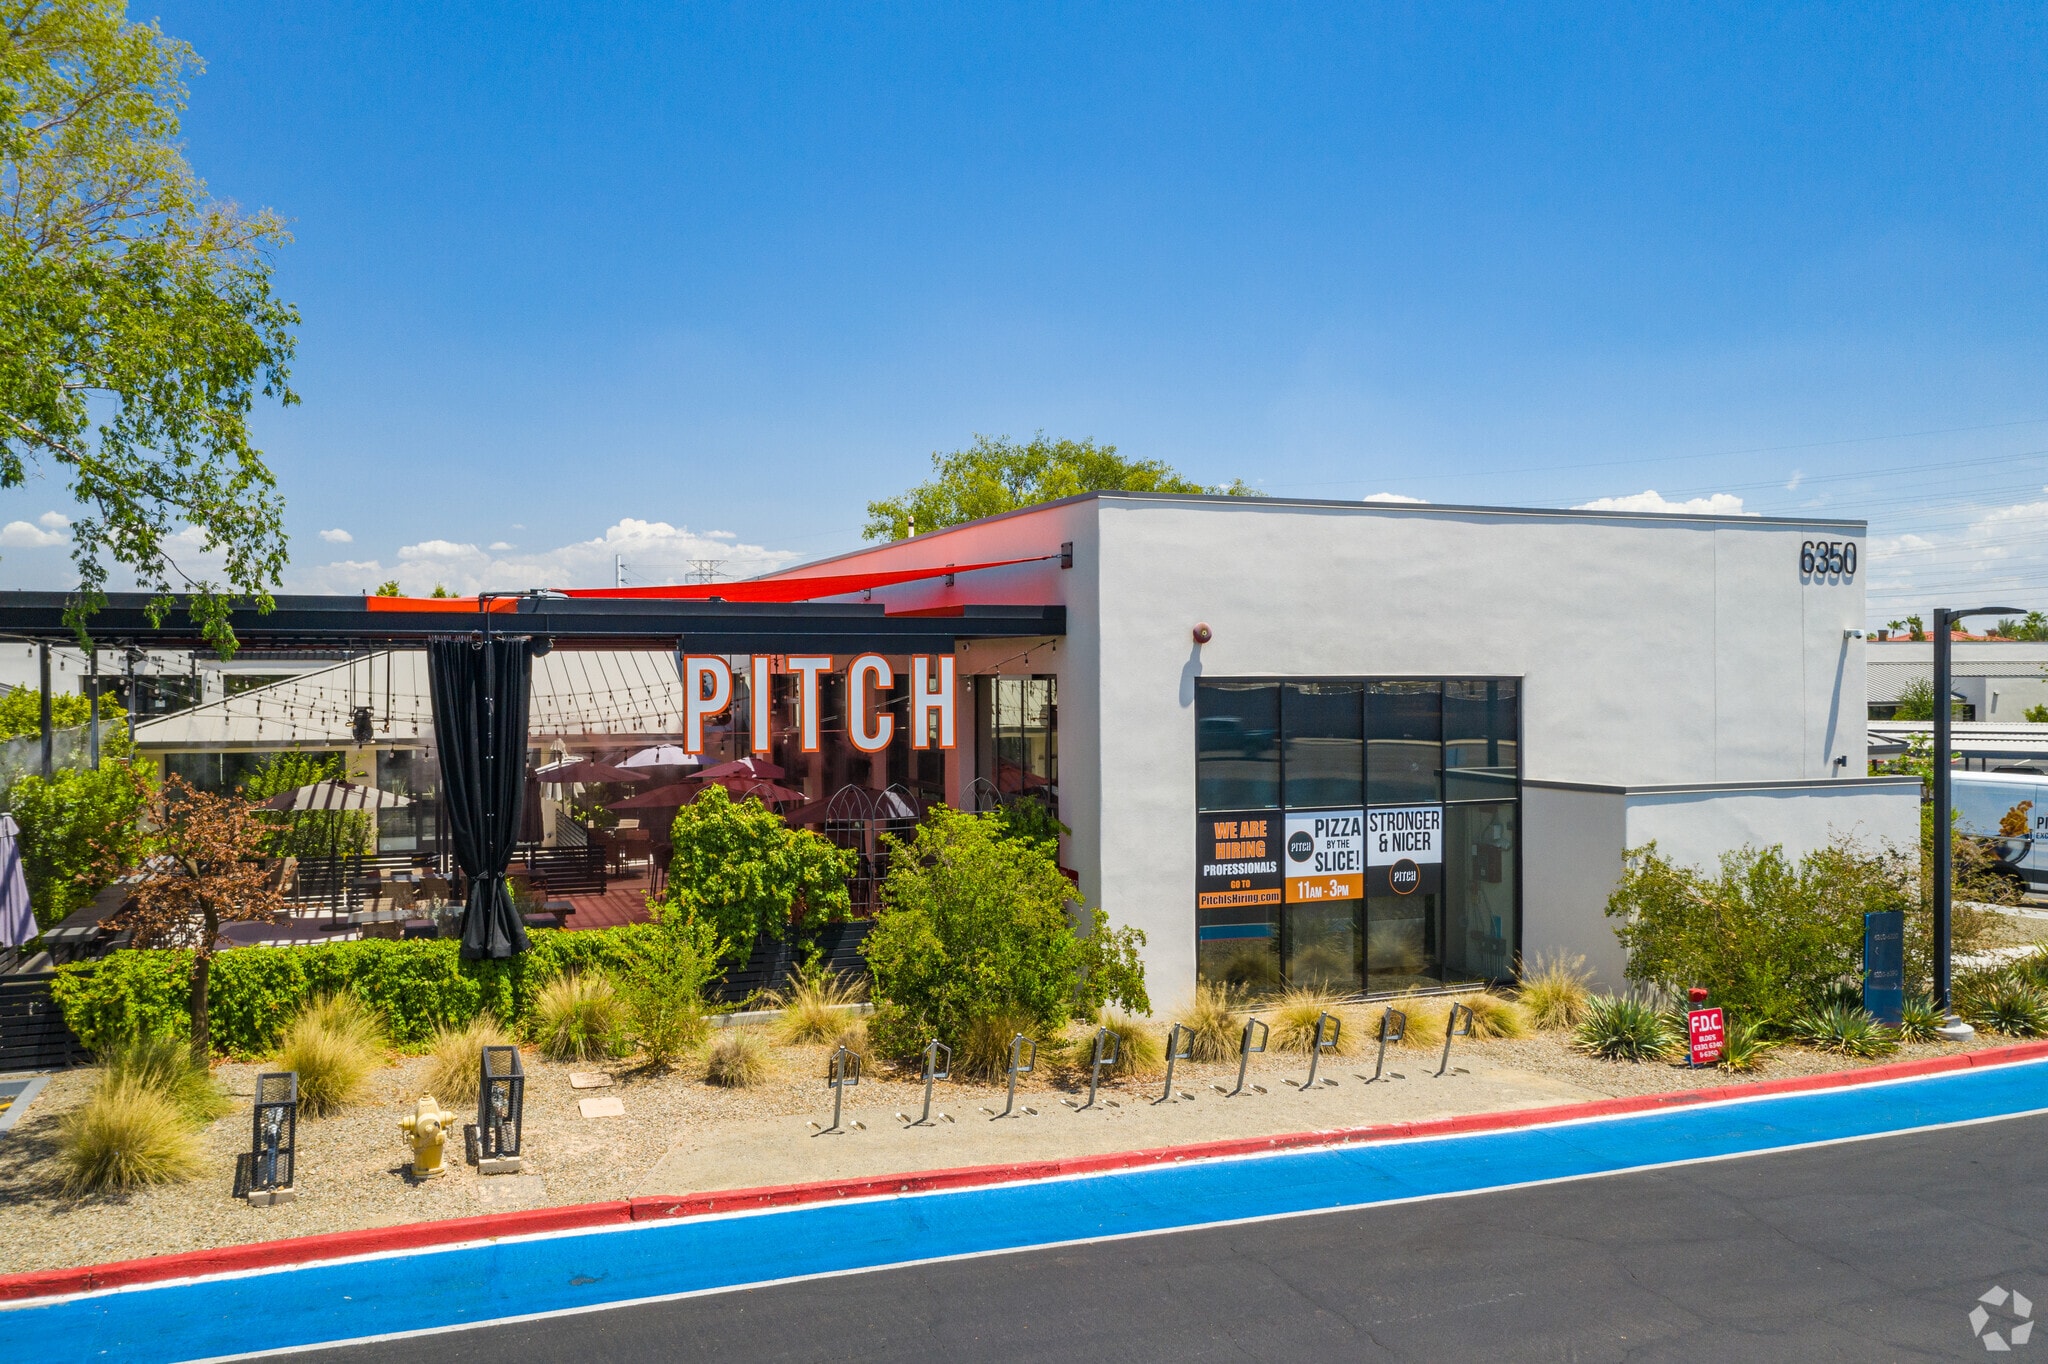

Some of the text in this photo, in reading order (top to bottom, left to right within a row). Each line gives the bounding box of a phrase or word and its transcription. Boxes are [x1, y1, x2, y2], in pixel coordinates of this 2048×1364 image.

[1801, 541, 1857, 574] 6350
[683, 652, 957, 755] PITCH
[1214, 820, 1268, 839] WE ARE
[1314, 817, 1361, 838] PIZZA
[1369, 811, 1440, 832] STRONGER
[1215, 840, 1266, 860] HIRING
[1291, 841, 1311, 853] PITCH
[1326, 839, 1350, 849] BY THE
[1379, 831, 1431, 852] & NICER
[1203, 861, 1277, 877] PROFESSIONALS
[1314, 850, 1360, 872] SLICE!
[1230, 879, 1251, 889] GO TO
[1393, 870, 1416, 882] PITCH
[1201, 893, 1279, 905] PitchIsHiring.com
[1297, 880, 1322, 899] 11AM
[1329, 879, 1349, 897] 3PM
[1691, 1013, 1722, 1033] F.D.C.
